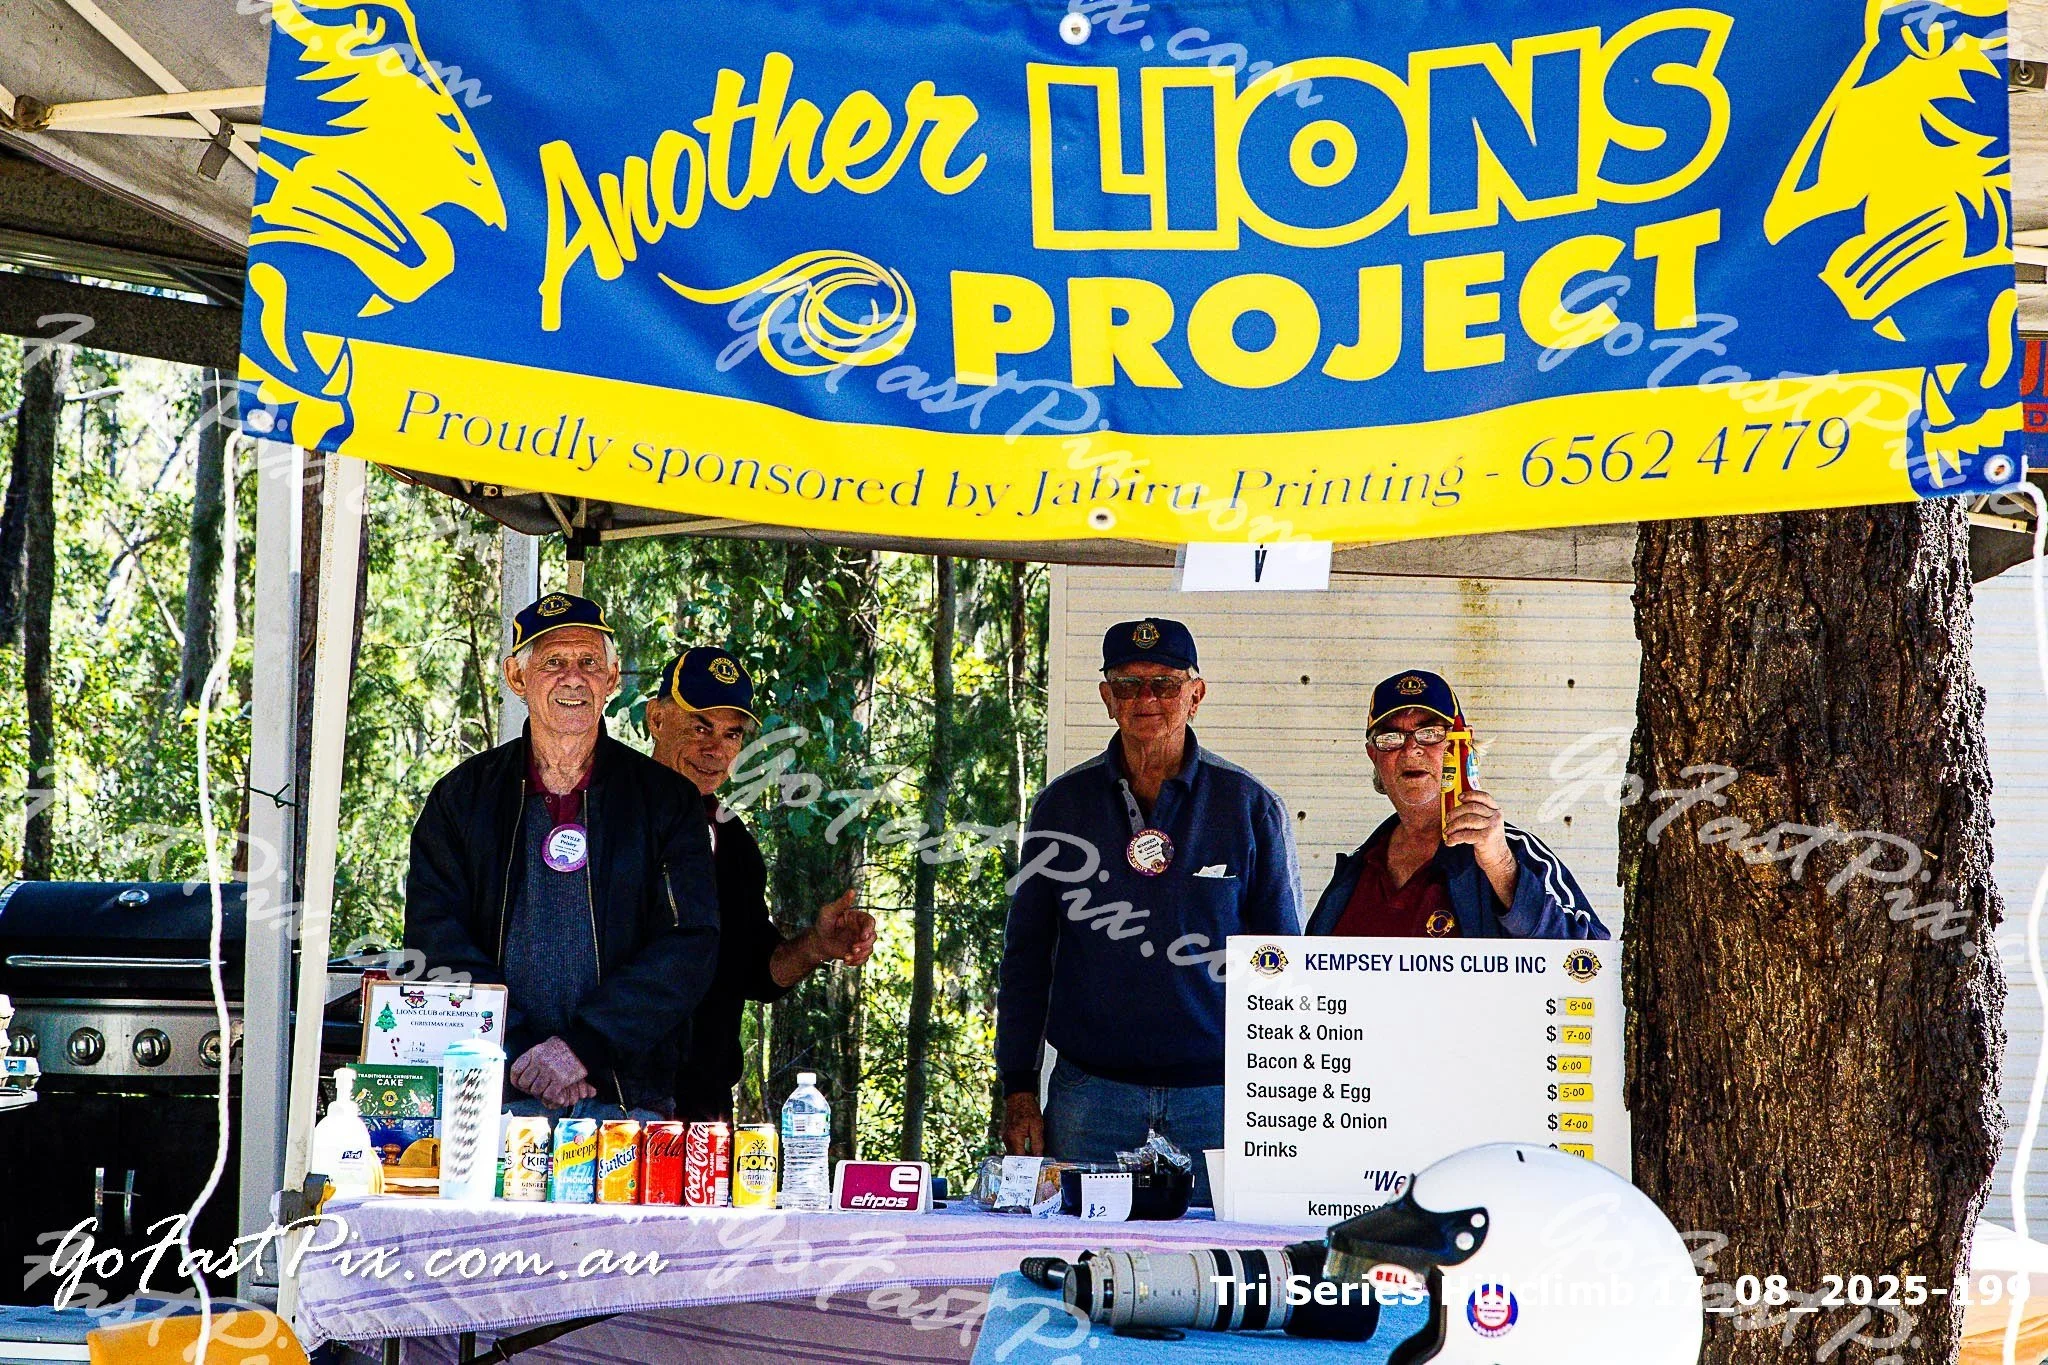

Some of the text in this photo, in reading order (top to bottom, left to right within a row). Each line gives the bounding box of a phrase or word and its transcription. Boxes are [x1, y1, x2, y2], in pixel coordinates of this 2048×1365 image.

[539, 9, 1734, 331] Another LIONS
[951, 209, 1720, 388] PROJECT
[397, 390, 613, 471] Proudly
[630, 440, 922, 507] sponsored
[947, 470, 1011, 516] by
[1017, 465, 1201, 517] Jabiru
[1230, 456, 1464, 510] Printing
[1520, 428, 1674, 488] 6562
[1697, 416, 1851, 475] 4779
[1264, 954, 1275, 968] L
[1305, 953, 1547, 973] KEMPSEY LIONS CLUB INC
[1577, 958, 1589, 972] L
[1247, 994, 1347, 1015] Steak & Egg
[1546, 998, 1557, 1015] $
[1247, 1024, 1363, 1041] Steak & Onion
[1546, 1025, 1557, 1042] $
[1247, 1053, 1351, 1073] Bacon & Egg
[1546, 1054, 1557, 1072] $
[376, 1079, 404, 1087] CAKE
[1246, 1082, 1371, 1103] Sausage & Egg
[1547, 1084, 1558, 1101] $
[1246, 1111, 1387, 1131] Sausage & Onion
[1547, 1113, 1558, 1131] $
[1244, 1141, 1298, 1158] Drinks
[740, 1155, 776, 1171] SOLO
[850, 1191, 910, 1209] eftpos
[1375, 1270, 1409, 1285] BELL
